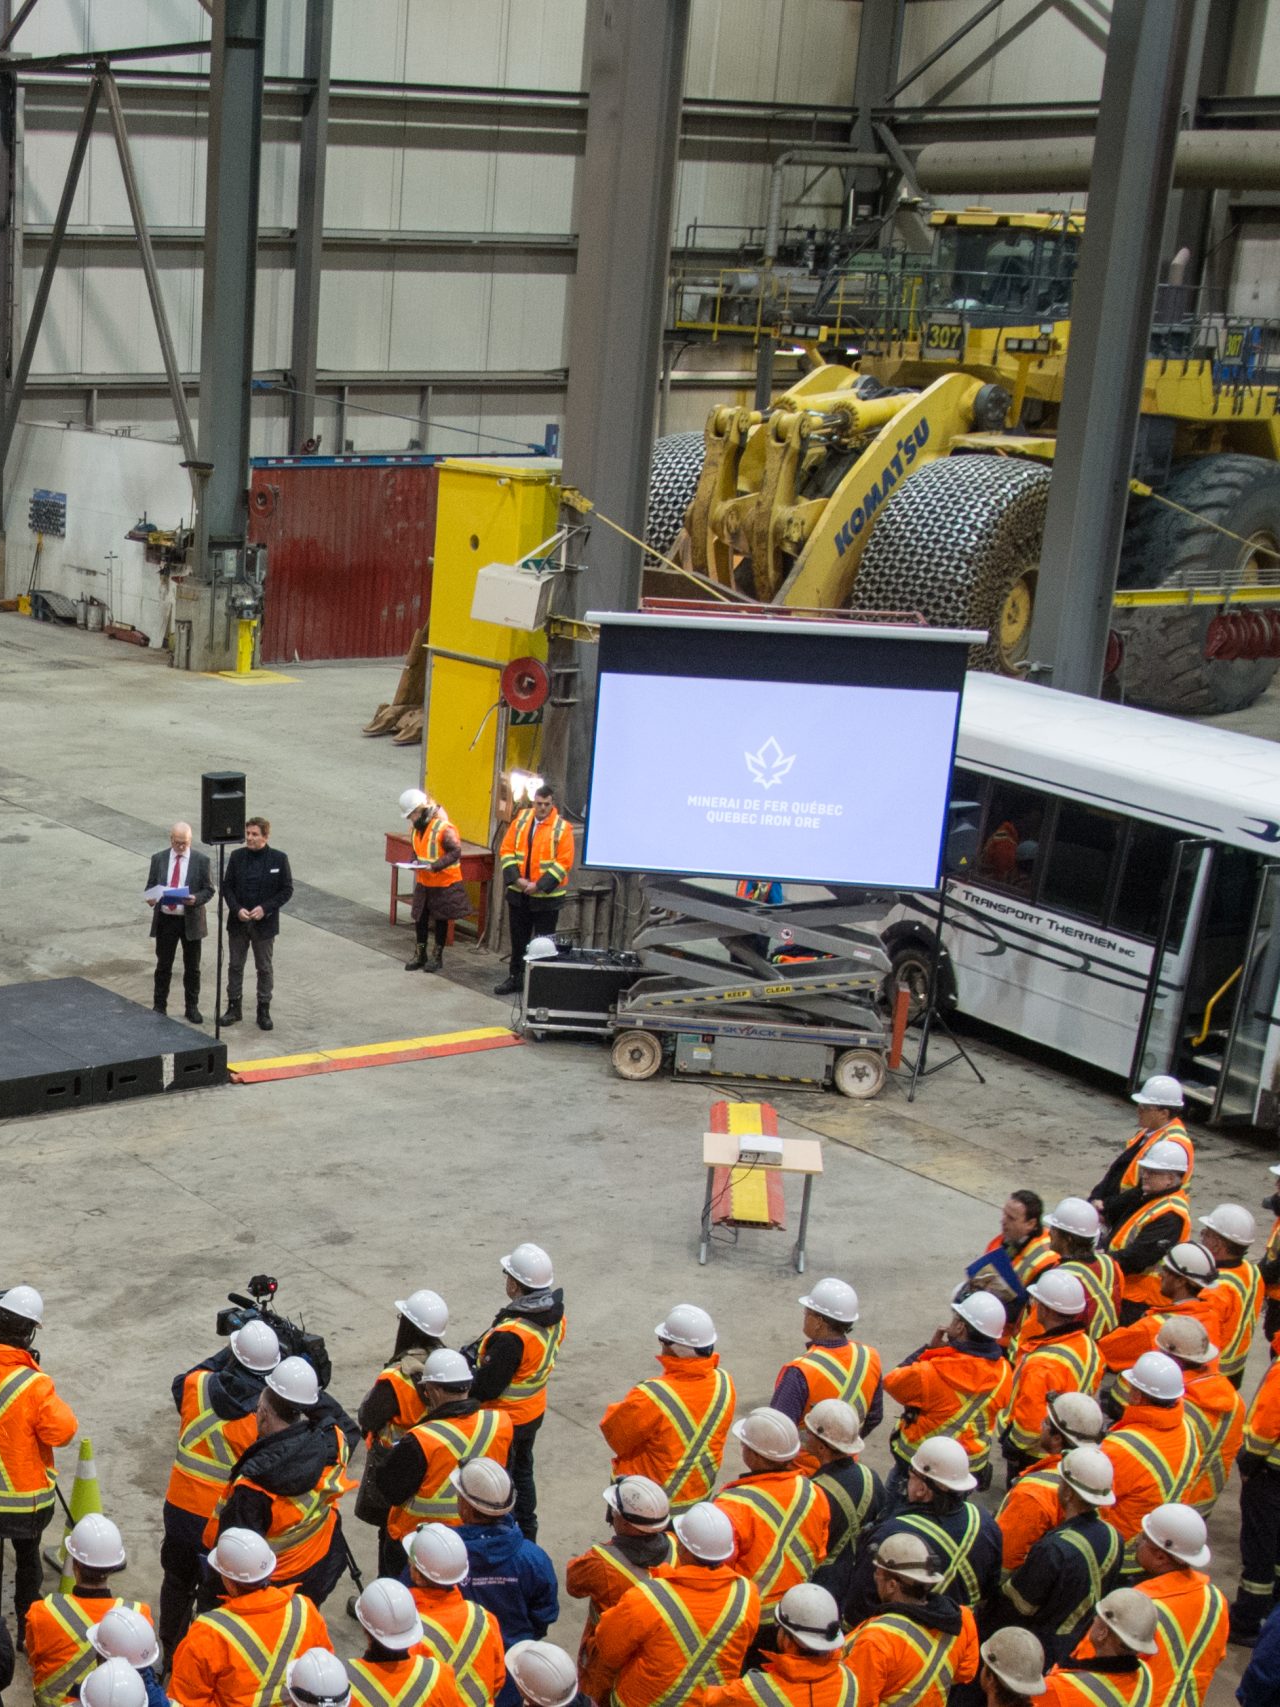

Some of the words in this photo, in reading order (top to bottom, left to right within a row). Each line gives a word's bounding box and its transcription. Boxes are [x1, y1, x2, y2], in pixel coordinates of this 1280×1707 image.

[928, 324, 962, 349] 307
[834, 416, 930, 558] KOMATSU
[687, 795, 740, 809] MINERAI
[743, 799, 761, 811] DE
[764, 800, 788, 812] FER
[791, 800, 843, 816] QUÉBEC
[706, 810, 757, 824] QUEBEC
[760, 814, 791, 827] IRON
[794, 816, 820, 829] ORE
[962, 889, 1043, 926] TRANSPORT
[1047, 918, 1117, 951] THERRIEN
[726, 990, 748, 998] KEEP
[765, 985, 791, 994] CLEAR
[722, 1025, 777, 1037] SKYJACK
